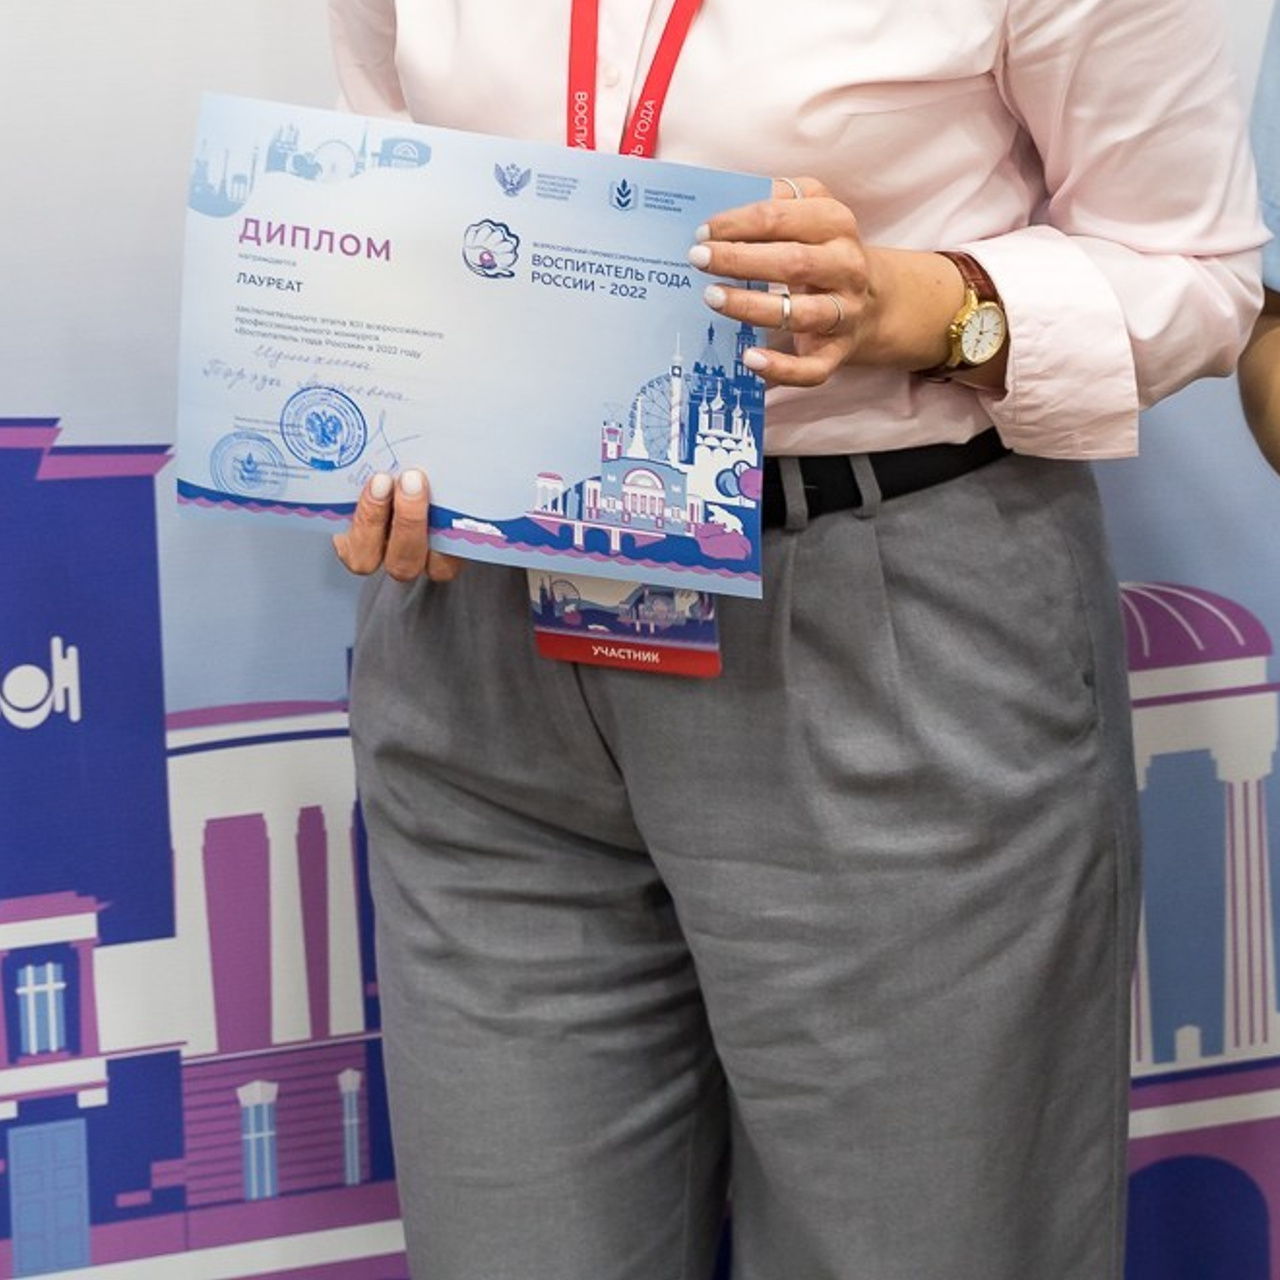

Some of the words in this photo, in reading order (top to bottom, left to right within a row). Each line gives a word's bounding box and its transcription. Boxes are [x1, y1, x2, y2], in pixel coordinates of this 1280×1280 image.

[634, 99, 656, 141] ГОДА
[238, 217, 392, 262] ДИПЛОМ
[236, 272, 304, 293] ЛАУРЕАТ
[531, 253, 645, 282] ВОСПИТАТЕЛЬ
[648, 269, 692, 289] ГОДА
[531, 271, 595, 292] РОССИИ
[609, 282, 648, 300] 2022
[375, 344, 398, 356] 2022
[399, 347, 422, 360] году
[590, 644, 661, 664] УЧАСТНИК
